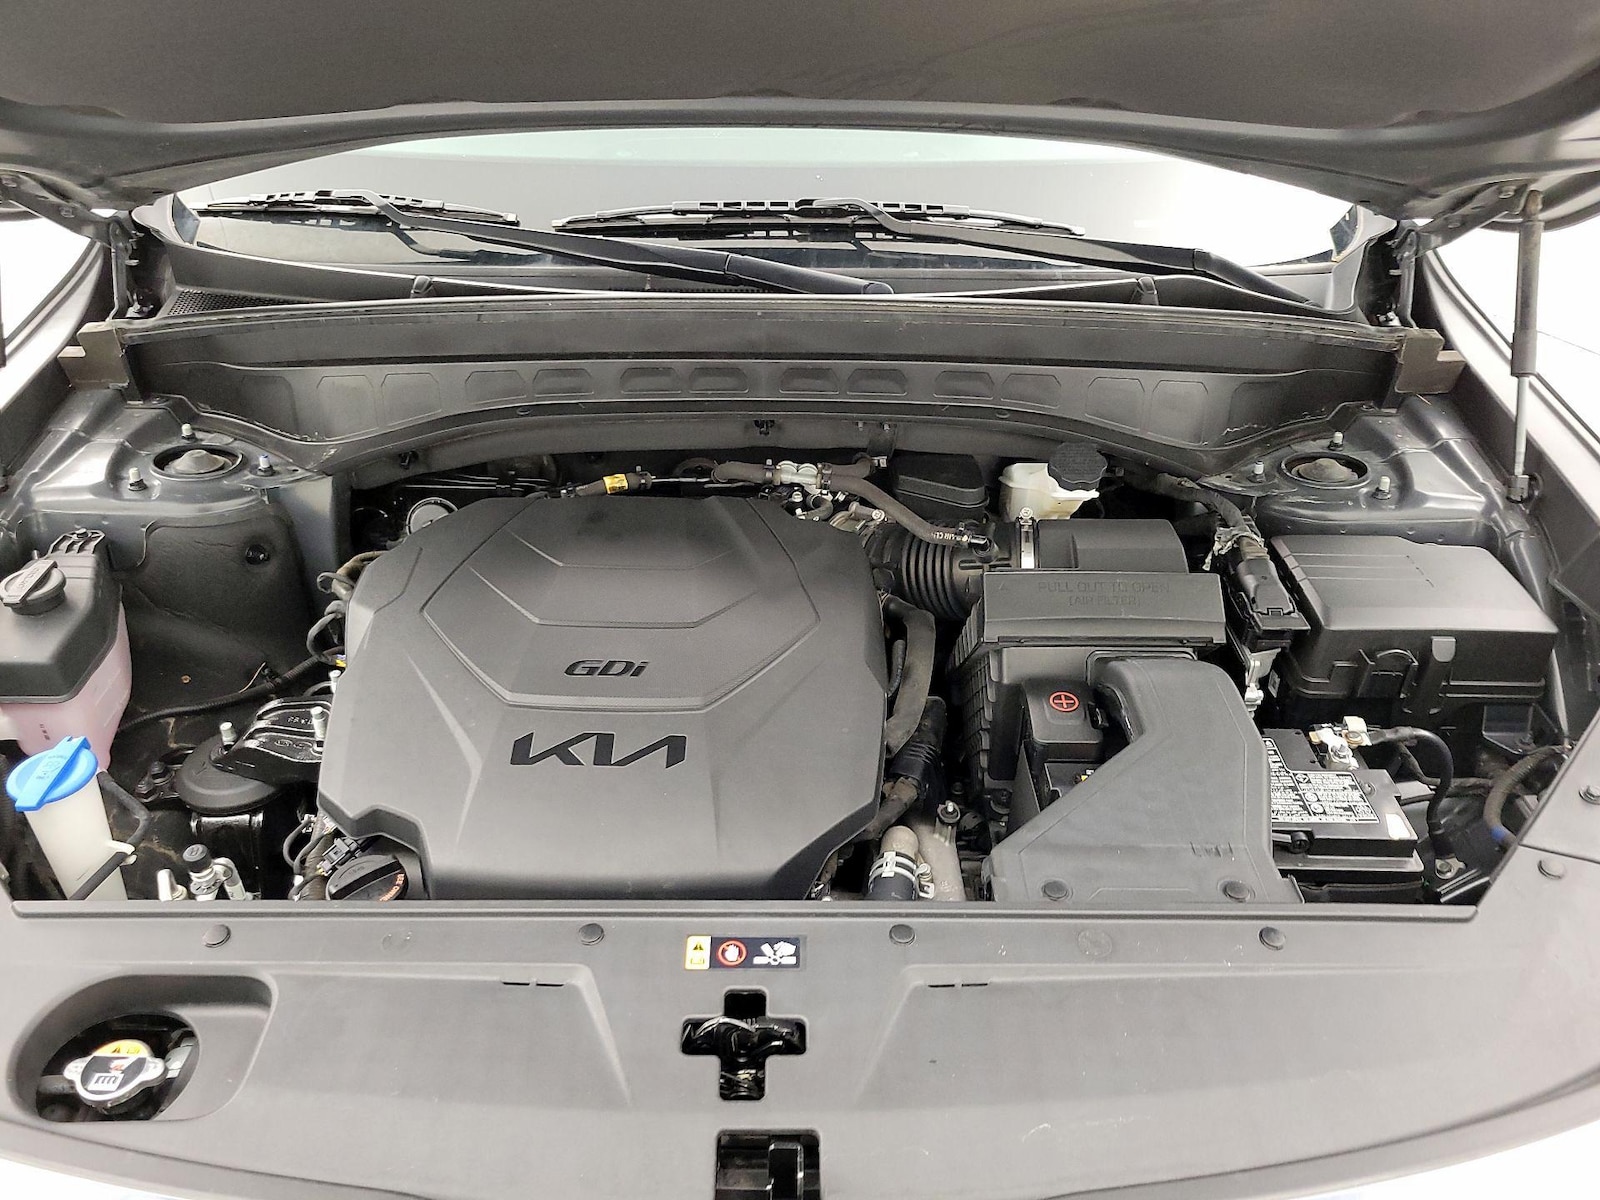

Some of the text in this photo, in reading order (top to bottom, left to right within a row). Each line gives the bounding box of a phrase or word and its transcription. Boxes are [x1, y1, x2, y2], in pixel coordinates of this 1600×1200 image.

[1038, 580, 1073, 593] PULL
[1077, 580, 1106, 593] OUT
[1131, 581, 1170, 593] OPEN
[564, 659, 648, 677] GDi
[510, 731, 688, 769] KIA
